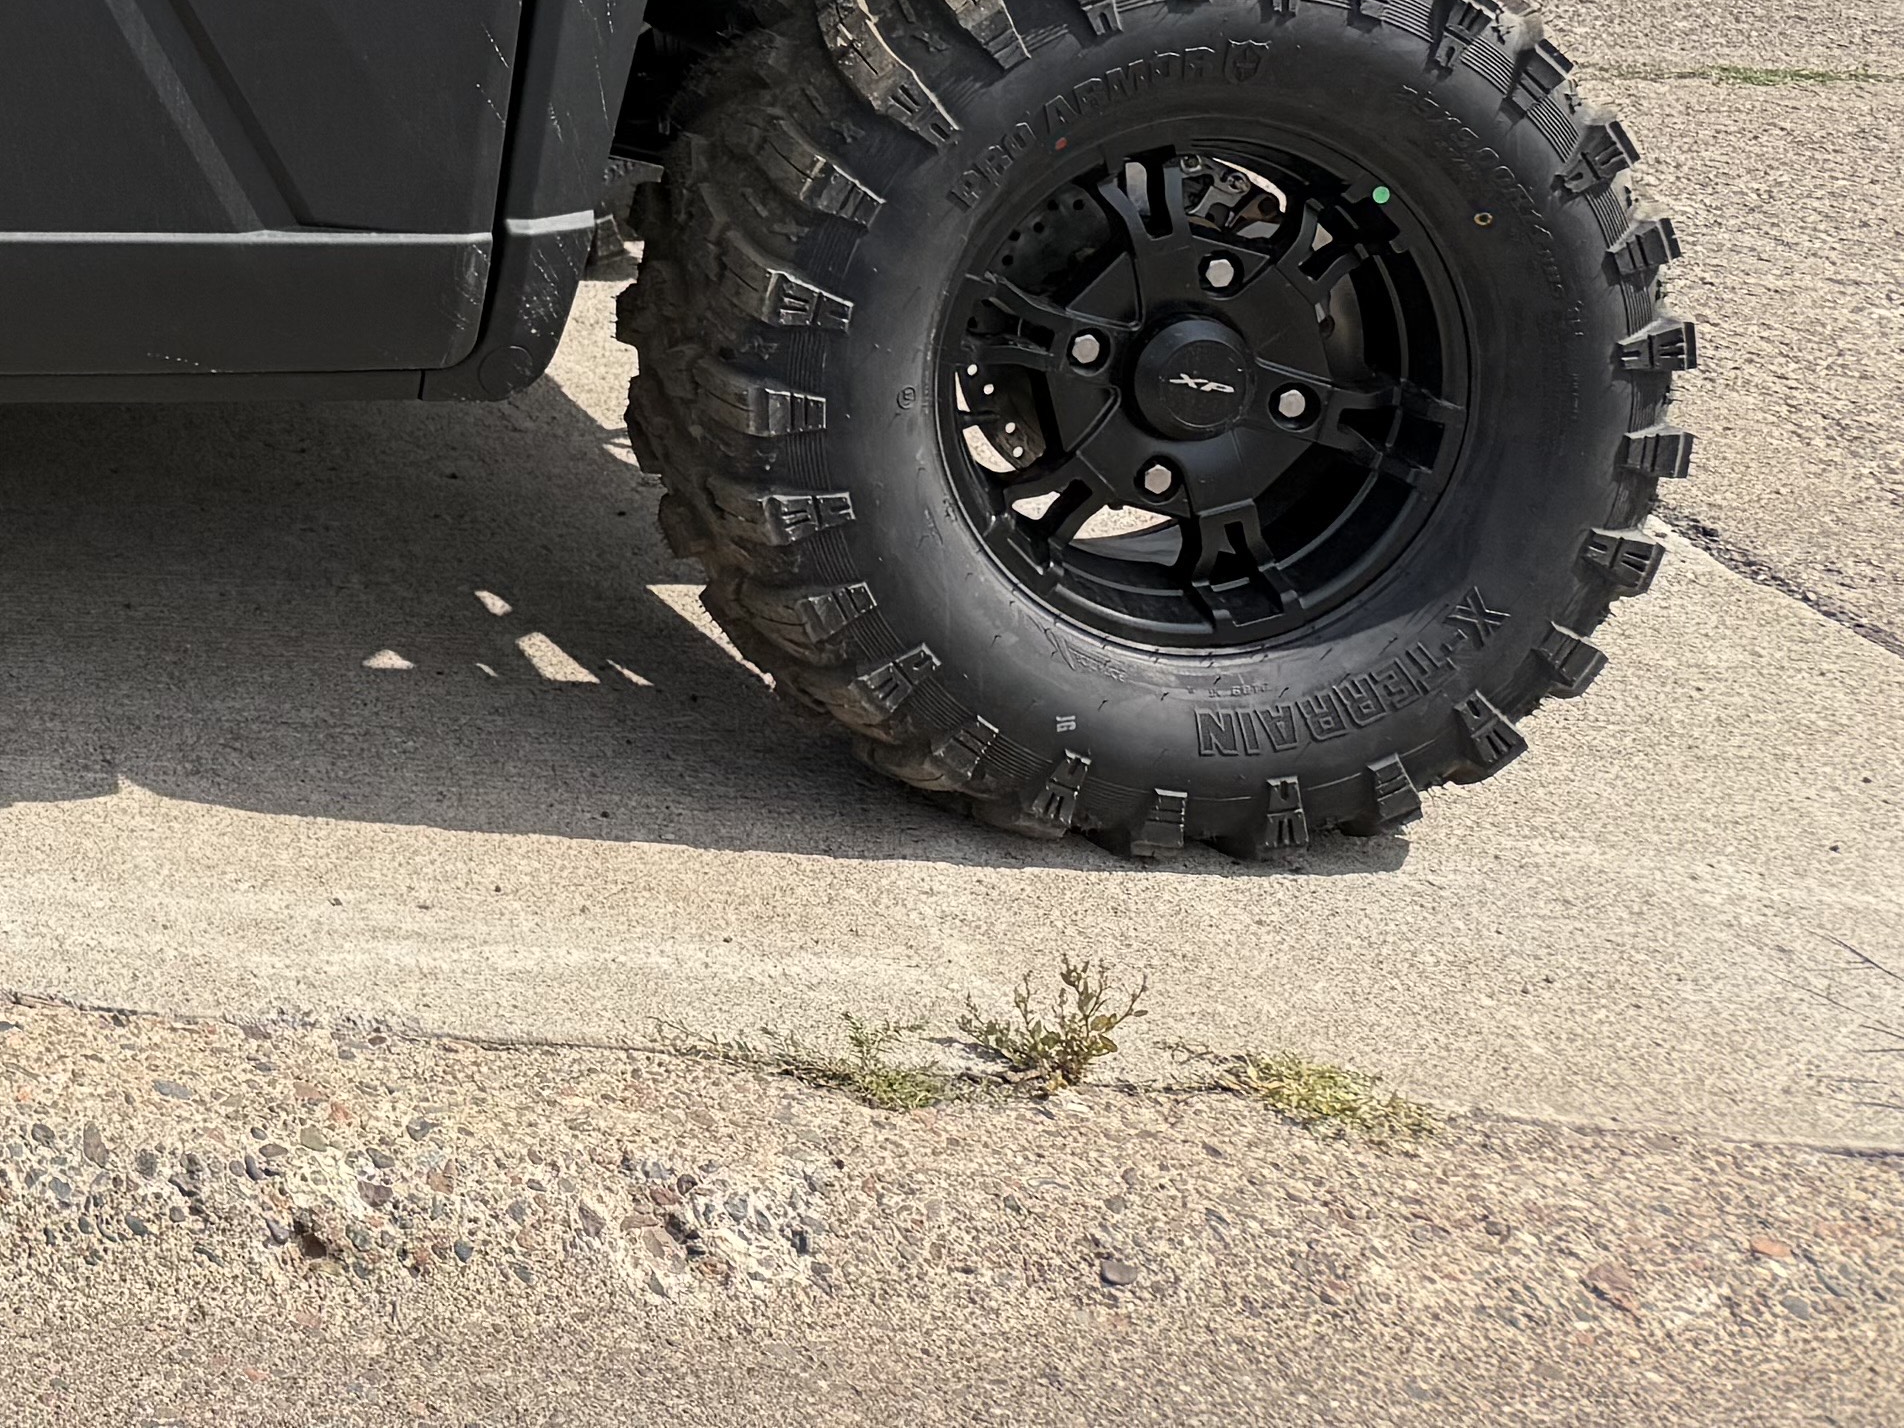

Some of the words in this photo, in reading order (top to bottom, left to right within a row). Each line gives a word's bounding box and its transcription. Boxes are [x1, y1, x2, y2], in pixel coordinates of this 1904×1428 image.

[947, 116, 1040, 214] PRO
[1043, 44, 1217, 134] ARMOR
[1168, 372, 1235, 394] XP
[1193, 585, 1512, 758] X-TERRAIN
